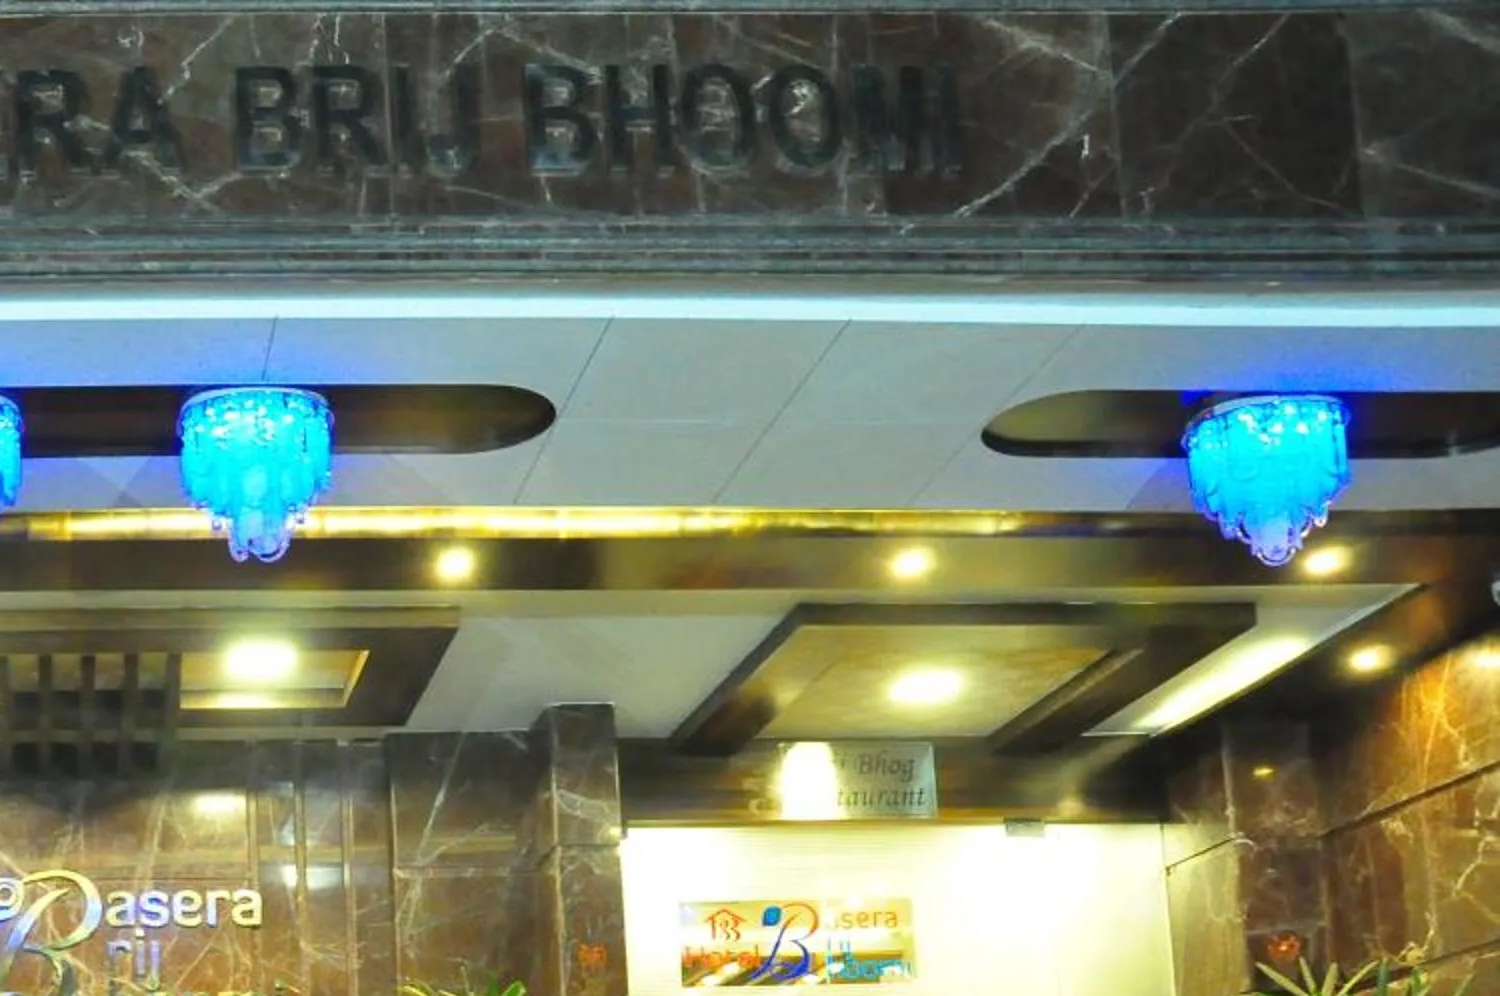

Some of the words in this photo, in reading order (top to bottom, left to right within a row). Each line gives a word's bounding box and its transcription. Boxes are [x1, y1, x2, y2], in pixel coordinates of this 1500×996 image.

[231, 64, 479, 180] BRIJ
[522, 62, 964, 178] BHOOMI
[856, 750, 915, 782] Bhog
[836, 787, 924, 807] taurant
